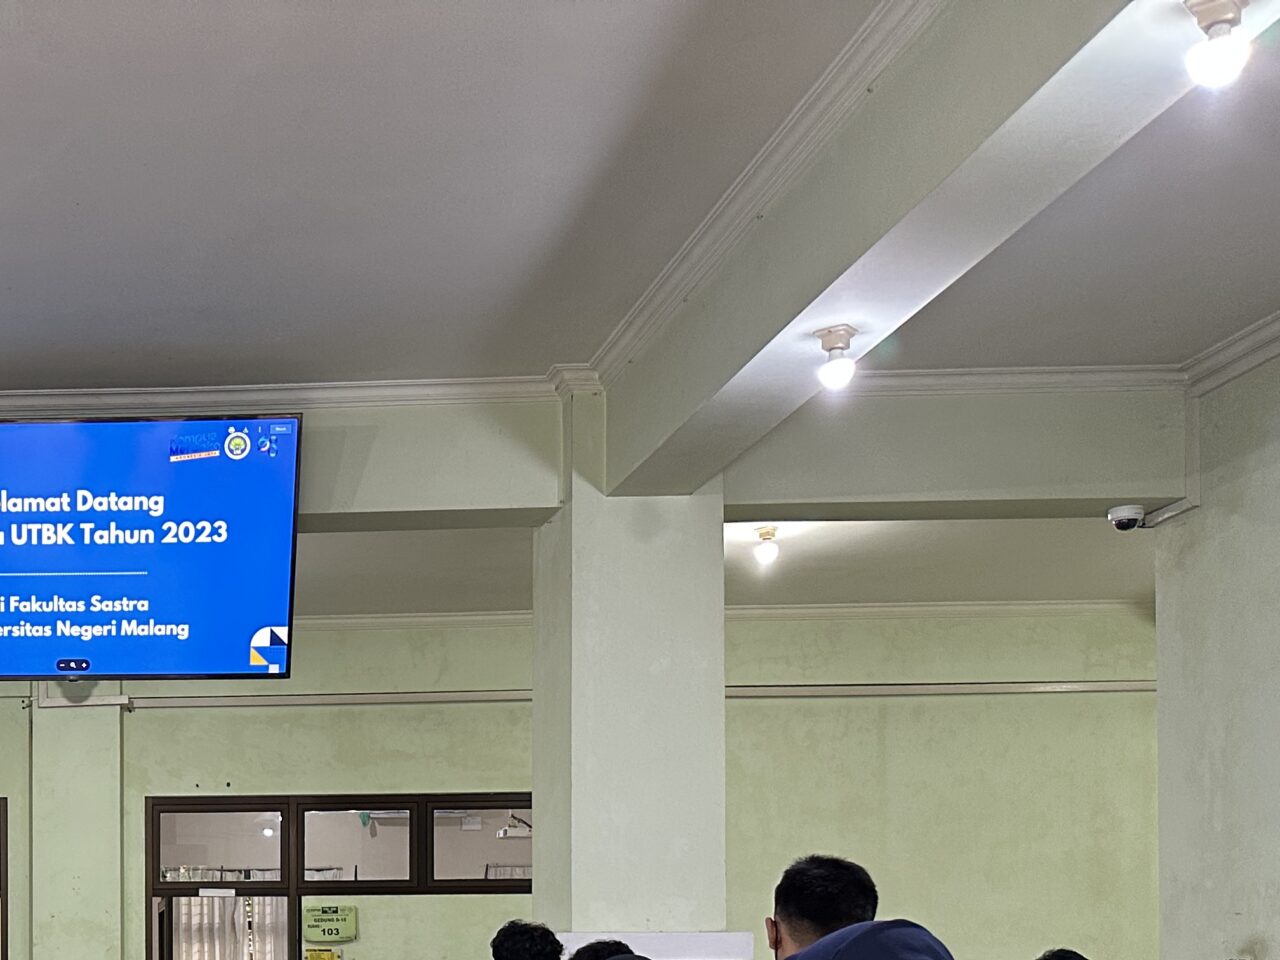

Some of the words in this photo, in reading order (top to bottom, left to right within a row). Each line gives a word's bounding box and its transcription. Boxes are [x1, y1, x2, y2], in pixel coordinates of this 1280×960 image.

[76, 489, 165, 517] Datang
[10, 522, 75, 546] UTBK
[79, 521, 155, 545] Tahun
[161, 520, 228, 544] 2023
[9, 594, 86, 613] Fakultas
[89, 594, 149, 612] Sastra
[56, 619, 117, 641] Negeri
[120, 618, 189, 640] Malang
[321, 928, 340, 936] 103
